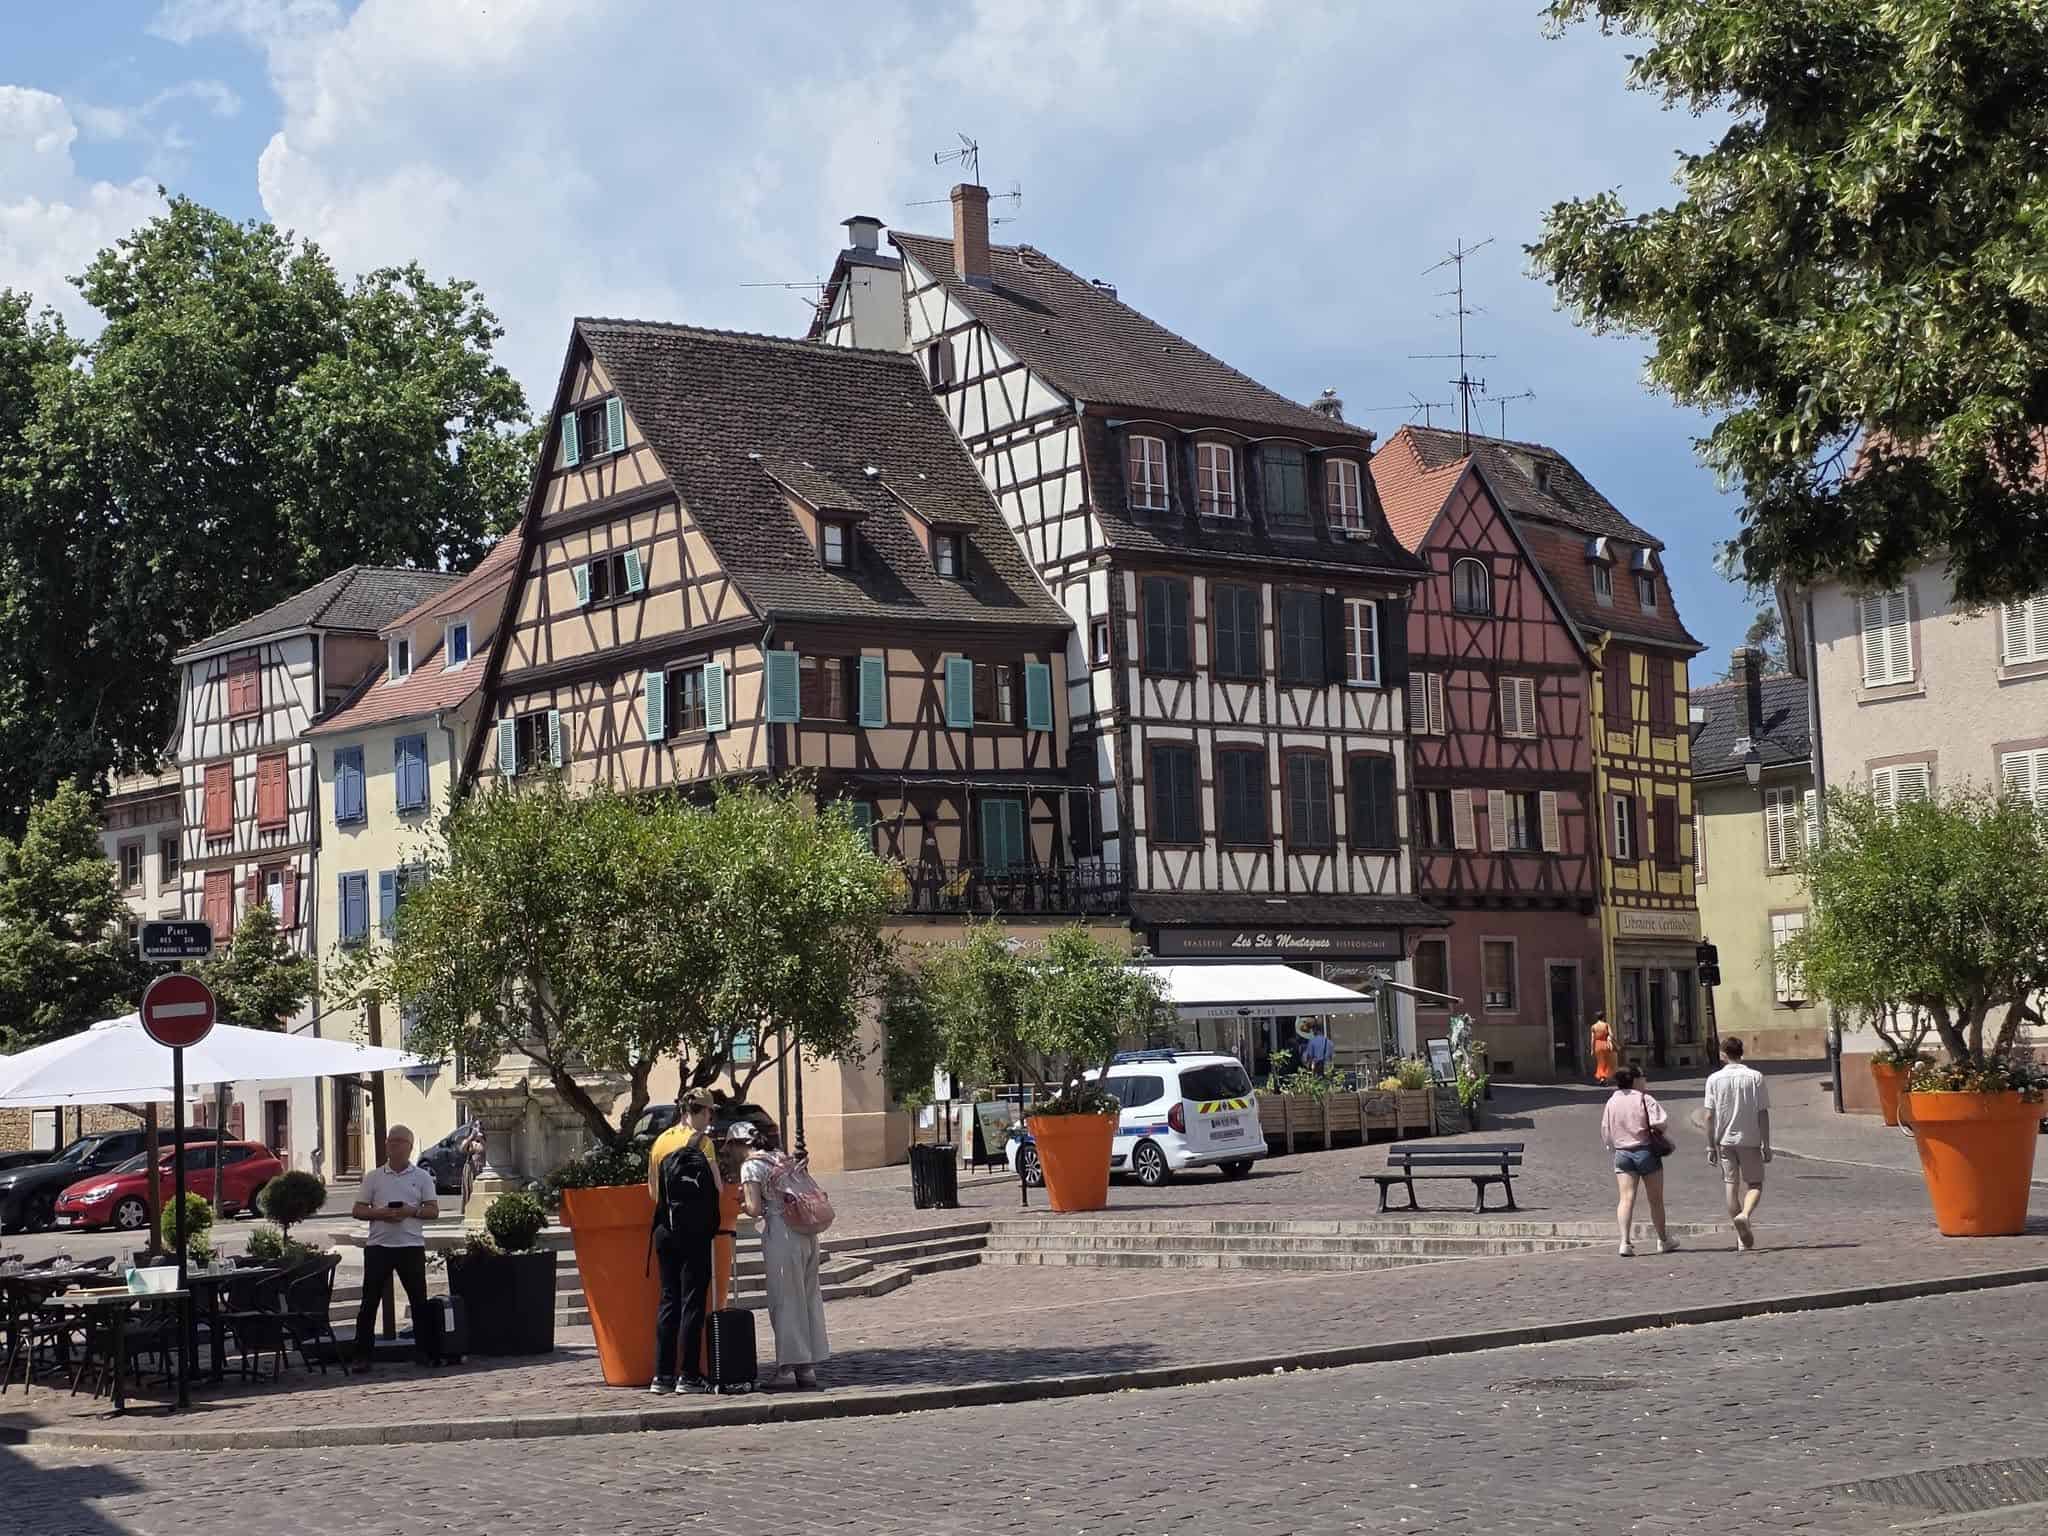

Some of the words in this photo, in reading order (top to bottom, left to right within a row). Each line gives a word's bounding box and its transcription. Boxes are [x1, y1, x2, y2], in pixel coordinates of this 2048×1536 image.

[1231, 933, 1252, 947] Les
[1254, 933, 1273, 948] Six
[1275, 933, 1330, 951] Montagnes
